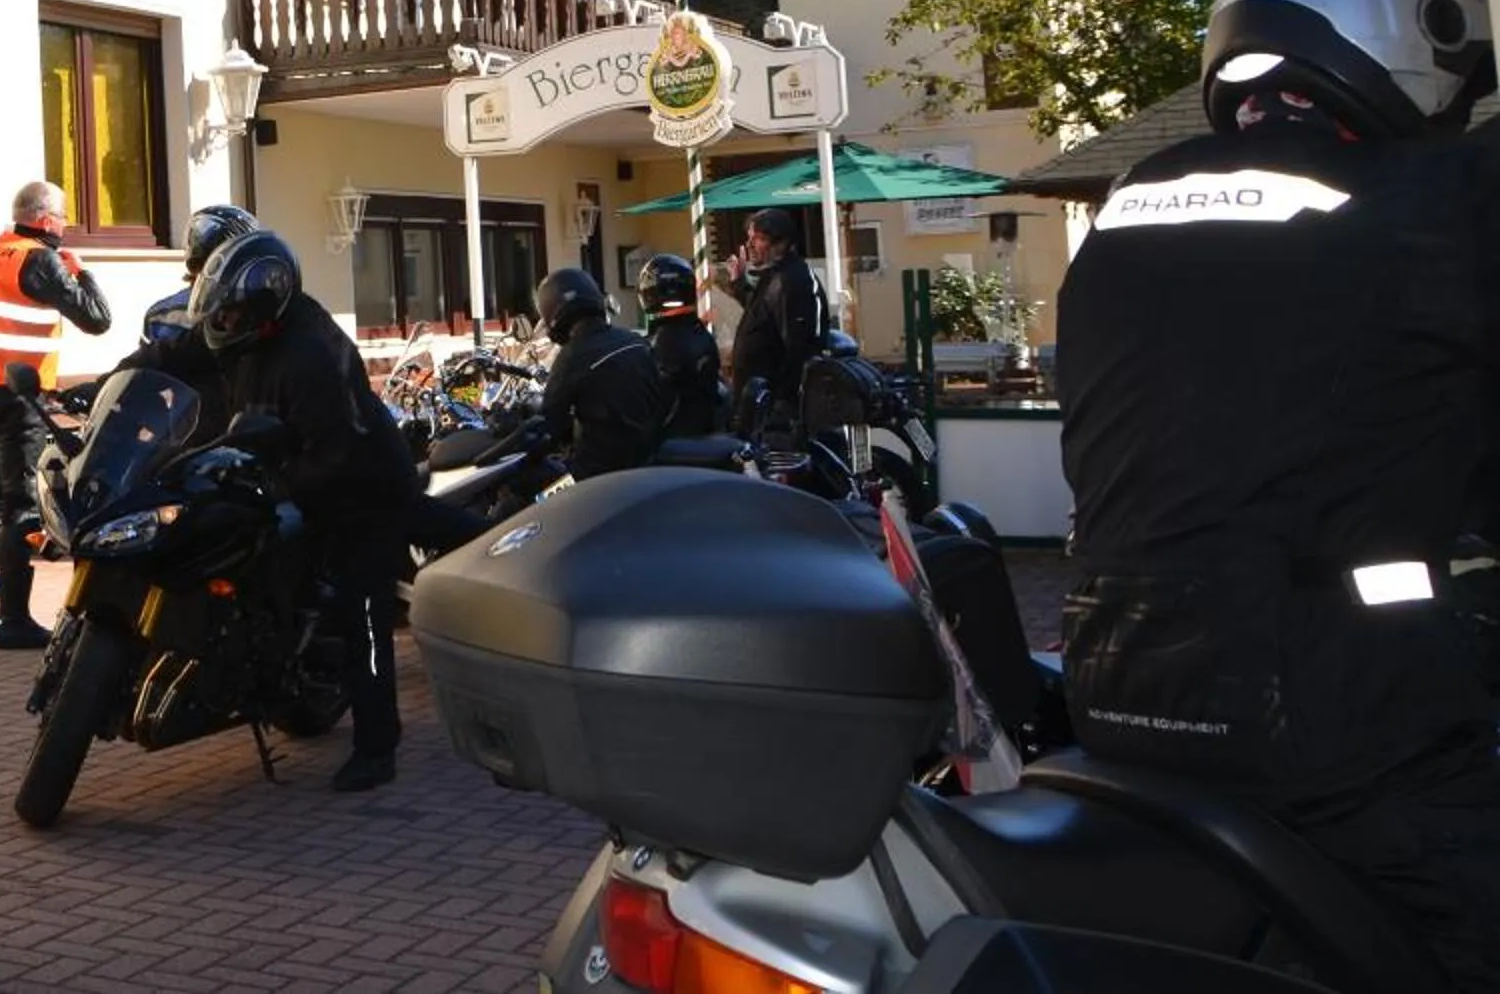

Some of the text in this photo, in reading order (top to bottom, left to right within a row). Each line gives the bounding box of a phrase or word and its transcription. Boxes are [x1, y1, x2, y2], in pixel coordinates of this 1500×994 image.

[1120, 189, 1263, 213] PHARAO
[1088, 708, 1229, 734] ADVENTURE EQUIPMENT
